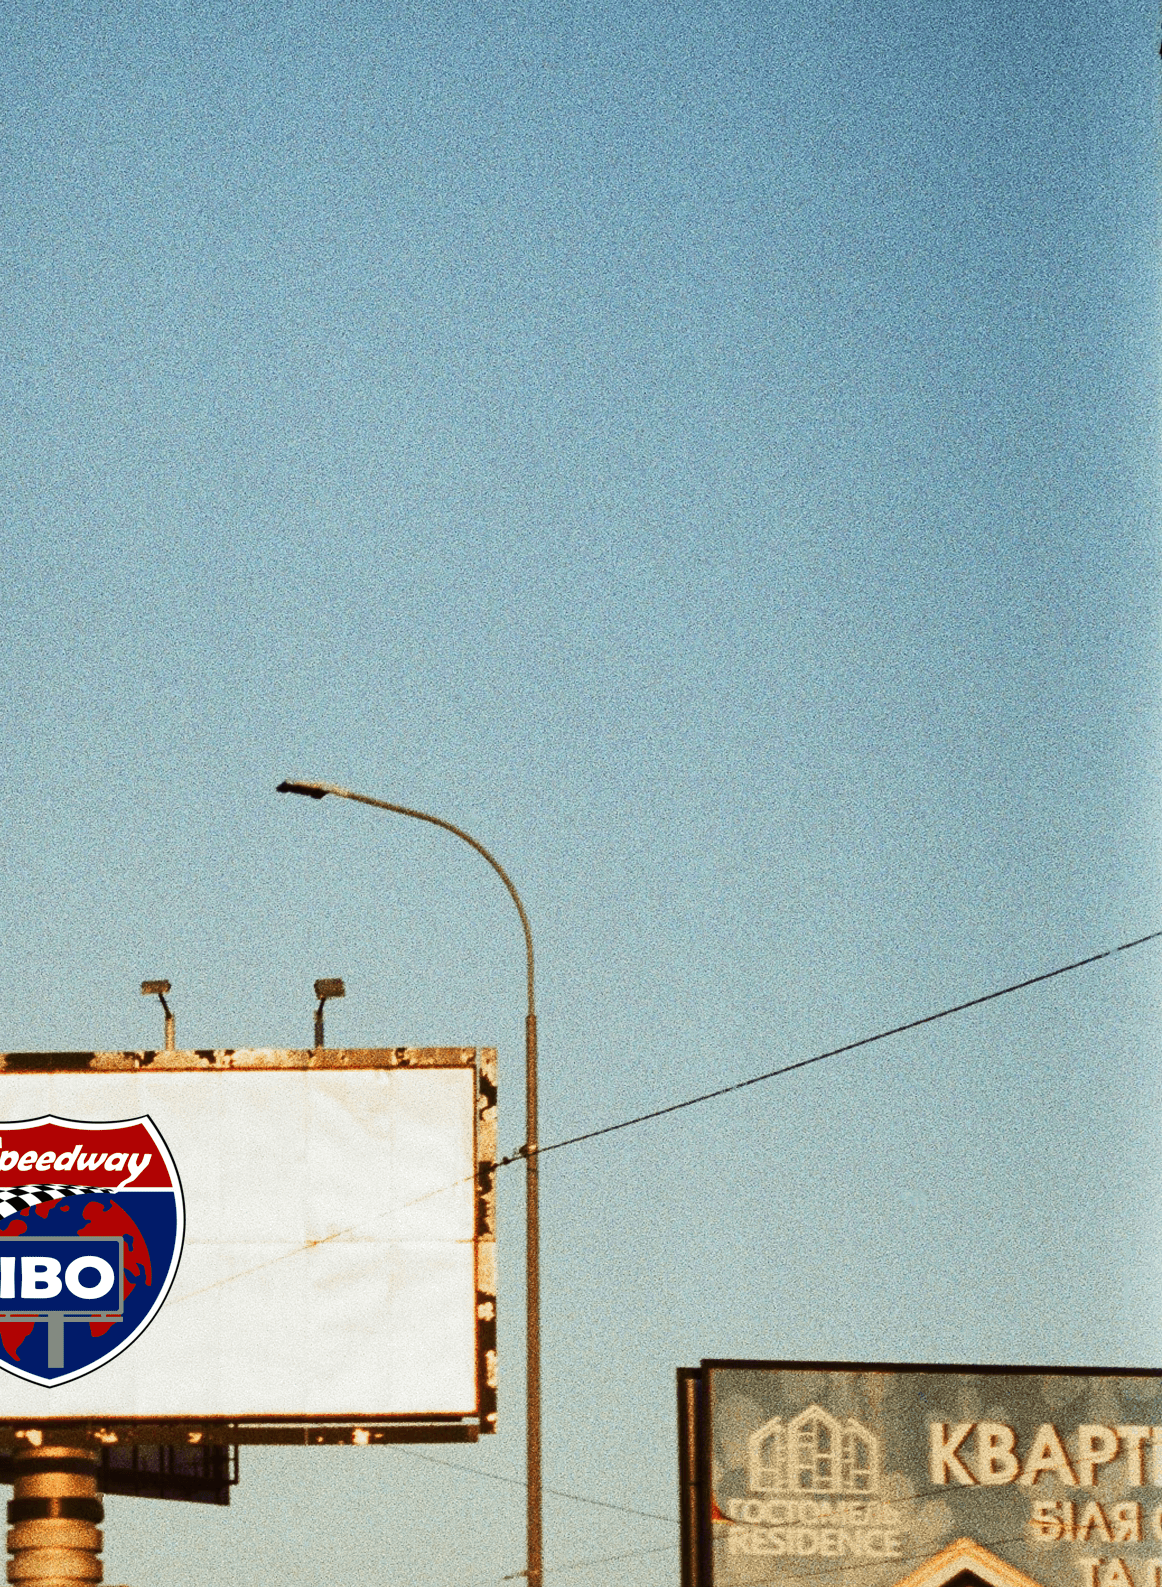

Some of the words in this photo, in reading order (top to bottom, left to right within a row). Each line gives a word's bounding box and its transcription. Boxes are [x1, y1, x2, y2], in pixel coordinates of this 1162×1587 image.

[0, 1255, 116, 1300] IBO
[728, 1527, 903, 1557] RESIDENCE
[1030, 1501, 1142, 1543] БІЛЯ
